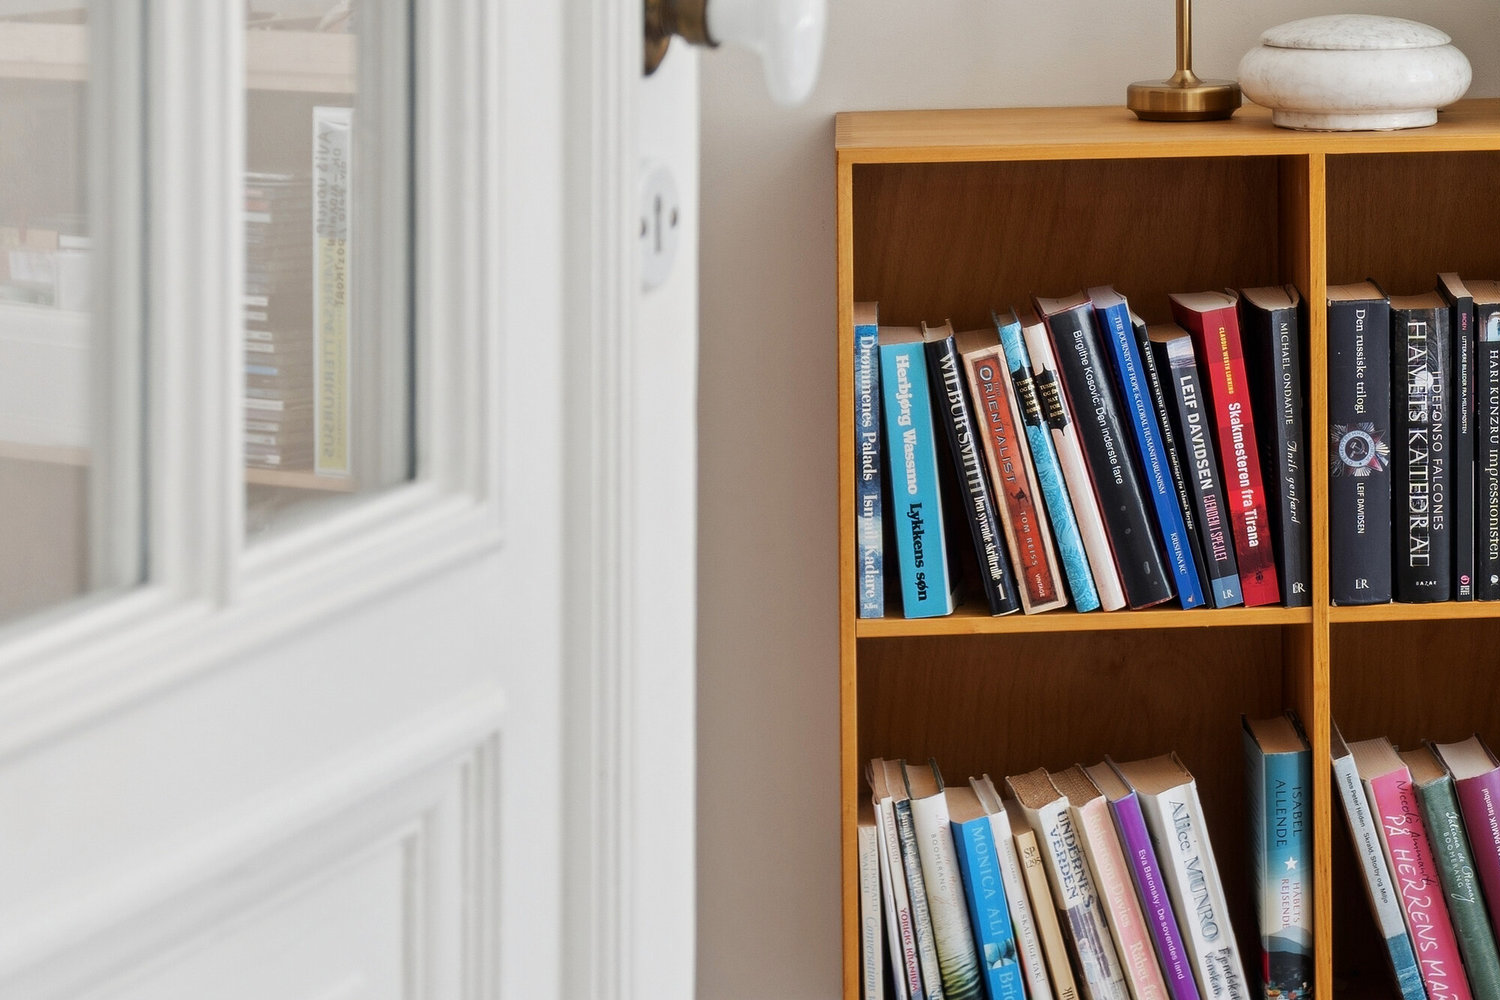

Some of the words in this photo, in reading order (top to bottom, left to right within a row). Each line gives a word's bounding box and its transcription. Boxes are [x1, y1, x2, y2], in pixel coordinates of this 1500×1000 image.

[1356, 309, 1365, 331] Den
[1280, 322, 1290, 369] MICHAEL
[1356, 335, 1366, 378] russiske
[1489, 349, 1498, 382] HARI
[859, 335, 876, 426] Drømmenes
[895, 354, 913, 425] Herbjørg
[939, 351, 969, 430] WILBUR
[1179, 375, 1197, 409] LEIF
[1407, 321, 1428, 421] HAVETS
[1072, 329, 1089, 366] Birgithe
[1095, 406, 1107, 426] Den
[1101, 426, 1118, 465] inderste
[1112, 465, 1123, 485] fare
[1282, 373, 1293, 424] ONDAATJE
[1354, 382, 1366, 413] trilogi
[1431, 371, 1442, 451] ILDEFONSO
[1489, 386, 1498, 443] KUNZRU
[978, 364, 1017, 484] ORIENTALIST
[1228, 402, 1250, 487] Skakmesteren
[861, 431, 877, 480] Palads
[902, 428, 917, 494] Wassmo
[956, 431, 984, 493] SMITH
[1187, 412, 1213, 489] DAVIDSEN
[1286, 440, 1298, 472] Anils
[973, 495, 987, 511] Den
[1202, 494, 1220, 526] FJENDEN
[1240, 488, 1254, 507] fra
[1285, 476, 1300, 523] genfærd
[1356, 482, 1364, 496] LEIF
[1408, 427, 1429, 567] KATEDRAL
[1432, 458, 1443, 530] FALCONES
[862, 494, 879, 538] Ismail
[907, 502, 925, 568] Lykkens
[975, 511, 994, 542] syvende
[1019, 510, 1030, 532] TOM
[1026, 537, 1038, 566] REISS
[1244, 508, 1259, 547] Tirana
[1356, 498, 1364, 533] DAVIDSEN
[984, 542, 1003, 580] skriftrulle
[1209, 531, 1227, 561] SPEJLET
[864, 544, 881, 597] Kadare
[914, 571, 928, 600] søn
[1271, 779, 1290, 847] ALLENDE
[1289, 786, 1305, 836] ISABEL
[1481, 787, 1495, 816] Istanbul
[1138, 848, 1148, 866] Eva
[1169, 800, 1192, 851] Alice
[1183, 855, 1219, 942] MUNRO
[971, 826, 996, 899] MONICA
[986, 908, 1004, 936] ALI
[1143, 865, 1161, 908] Baronsky:
[1156, 908, 1165, 920] De
[1160, 921, 1178, 960] sovendes
[1173, 960, 1185, 980] land
